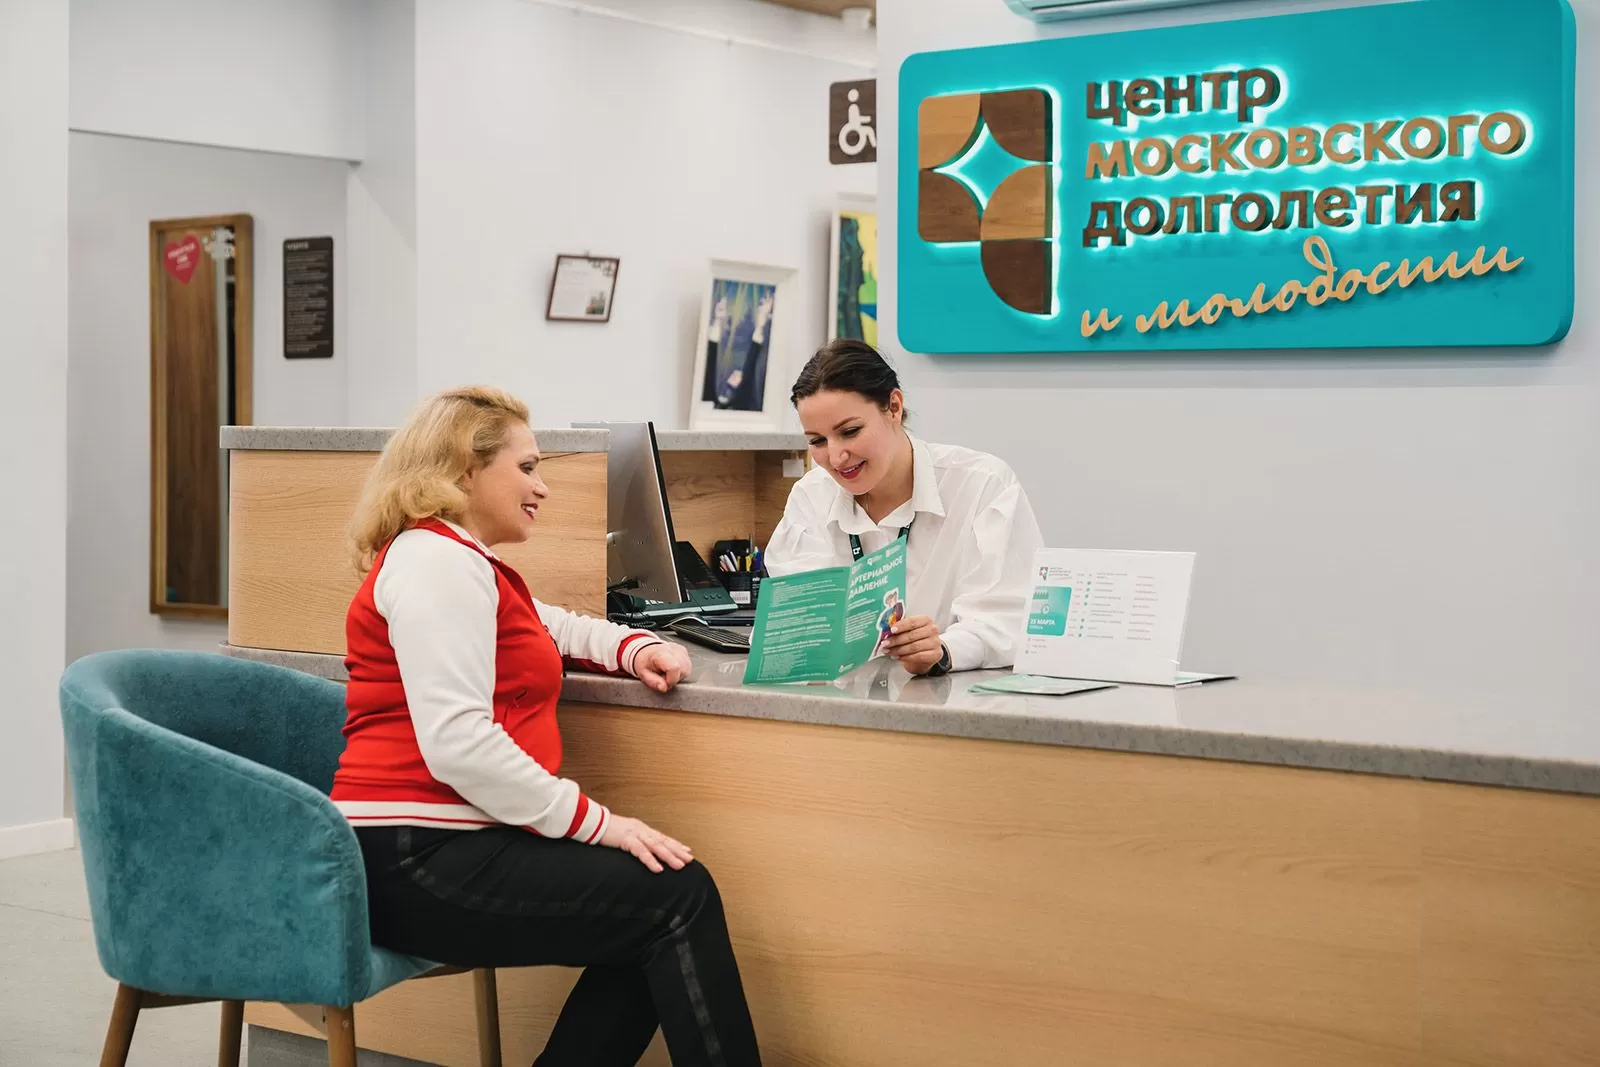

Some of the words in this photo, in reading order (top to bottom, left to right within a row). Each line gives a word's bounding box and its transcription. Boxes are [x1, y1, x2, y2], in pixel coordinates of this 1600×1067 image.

[1086, 68, 1281, 127] центр
[1085, 111, 1527, 179] московского
[1082, 180, 1476, 248] долголетия
[1081, 307, 1123, 337] и
[1135, 235, 1524, 333] молодости
[848, 575, 889, 600] ДАВЛЕНИЕ
[850, 555, 903, 588] АРТЕРИАЛЬНОЕ
